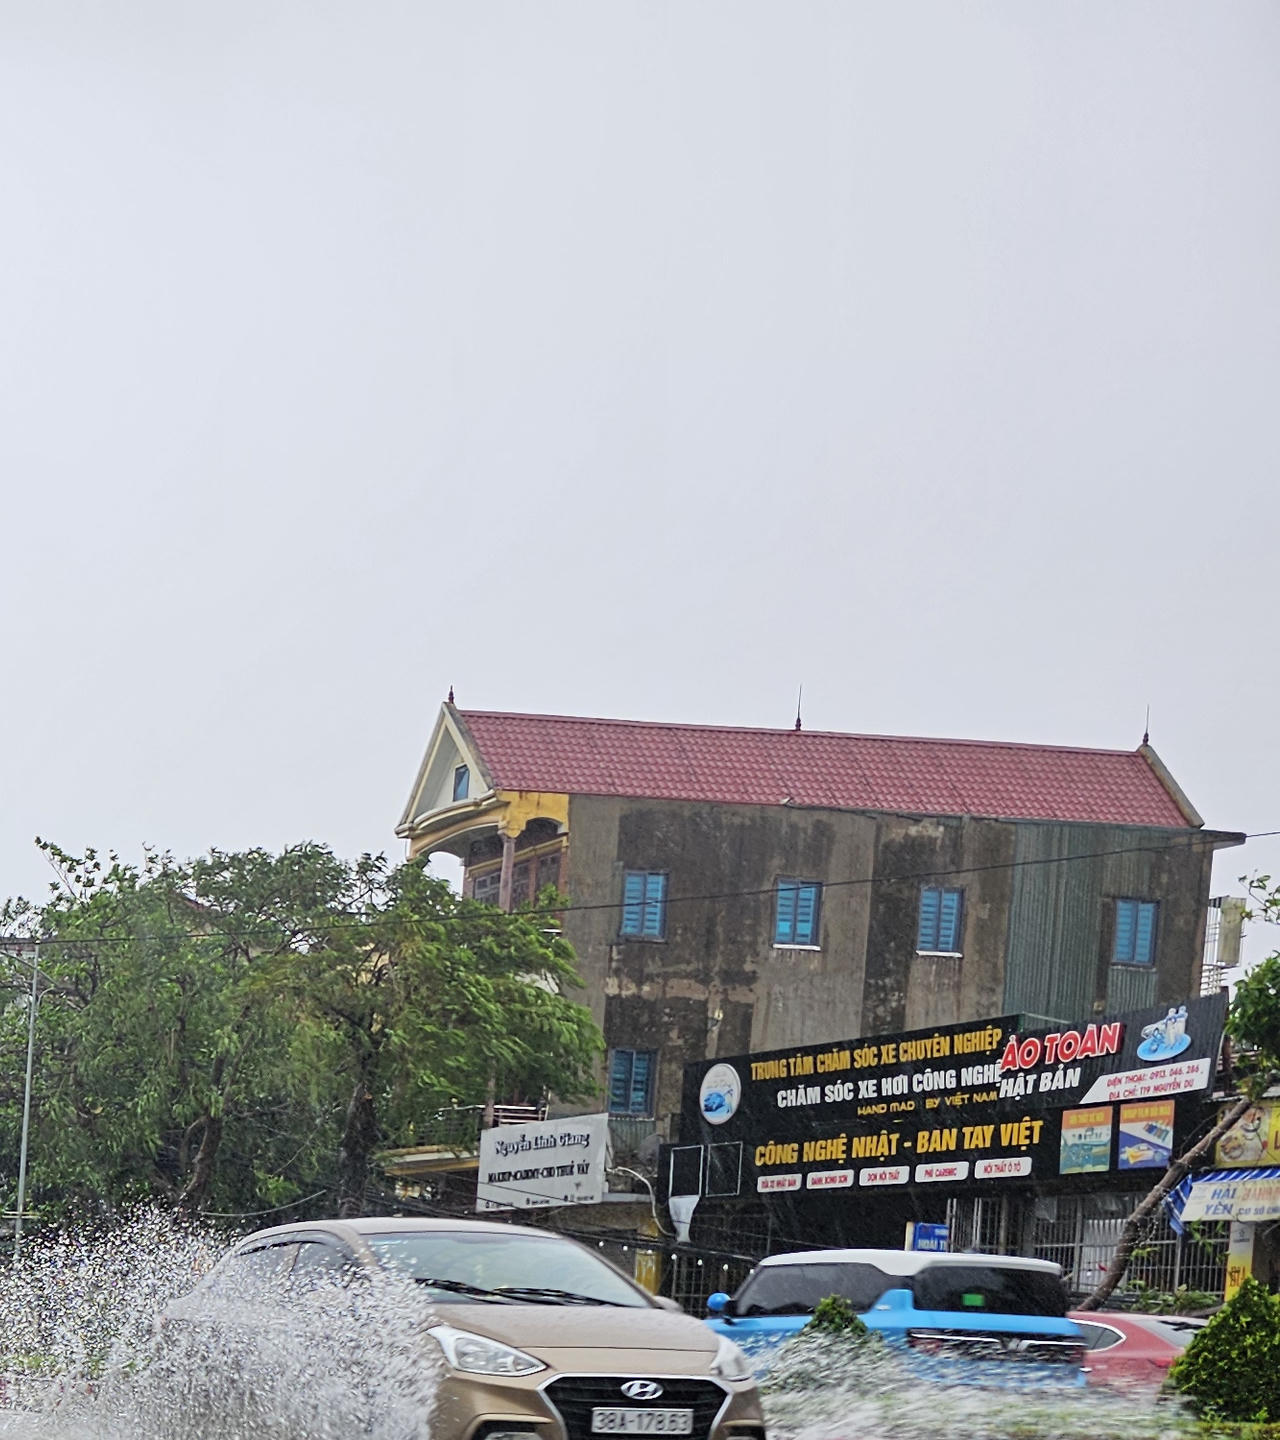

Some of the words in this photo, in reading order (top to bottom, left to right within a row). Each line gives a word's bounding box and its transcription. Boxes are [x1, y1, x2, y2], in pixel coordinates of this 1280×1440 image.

[751, 1059, 788, 1080] TRUNG
[788, 1053, 815, 1076] TÂM
[816, 1048, 851, 1073] CHĂM
[853, 1043, 878, 1068] SÓC
[880, 1044, 897, 1065] XE
[898, 1033, 951, 1062] CHUYÊN
[953, 1025, 1002, 1055] NGHIỆP
[777, 1084, 821, 1108] CHĂM
[824, 1080, 854, 1103] SÓC
[858, 1079, 878, 1099] XE
[881, 1074, 909, 1096] HƠI
[912, 1068, 957, 1093] CÔNG
[961, 1059, 1002, 1087] NGHỆ
[1039, 1064, 1081, 1092] BẢN
[857, 1103, 888, 1116] HAND
[925, 1097, 941, 1109] BY
[944, 1092, 970, 1109] VIỆT
[972, 1091, 998, 1103] NAM
[754, 1141, 799, 1166] CÔNG
[802, 1133, 848, 1164] NGHỆ
[851, 1129, 900, 1162] NHẬT
[916, 1128, 958, 1154] BAN
[961, 1124, 995, 1150] TAY
[1000, 1116, 1044, 1151] VIỆT
